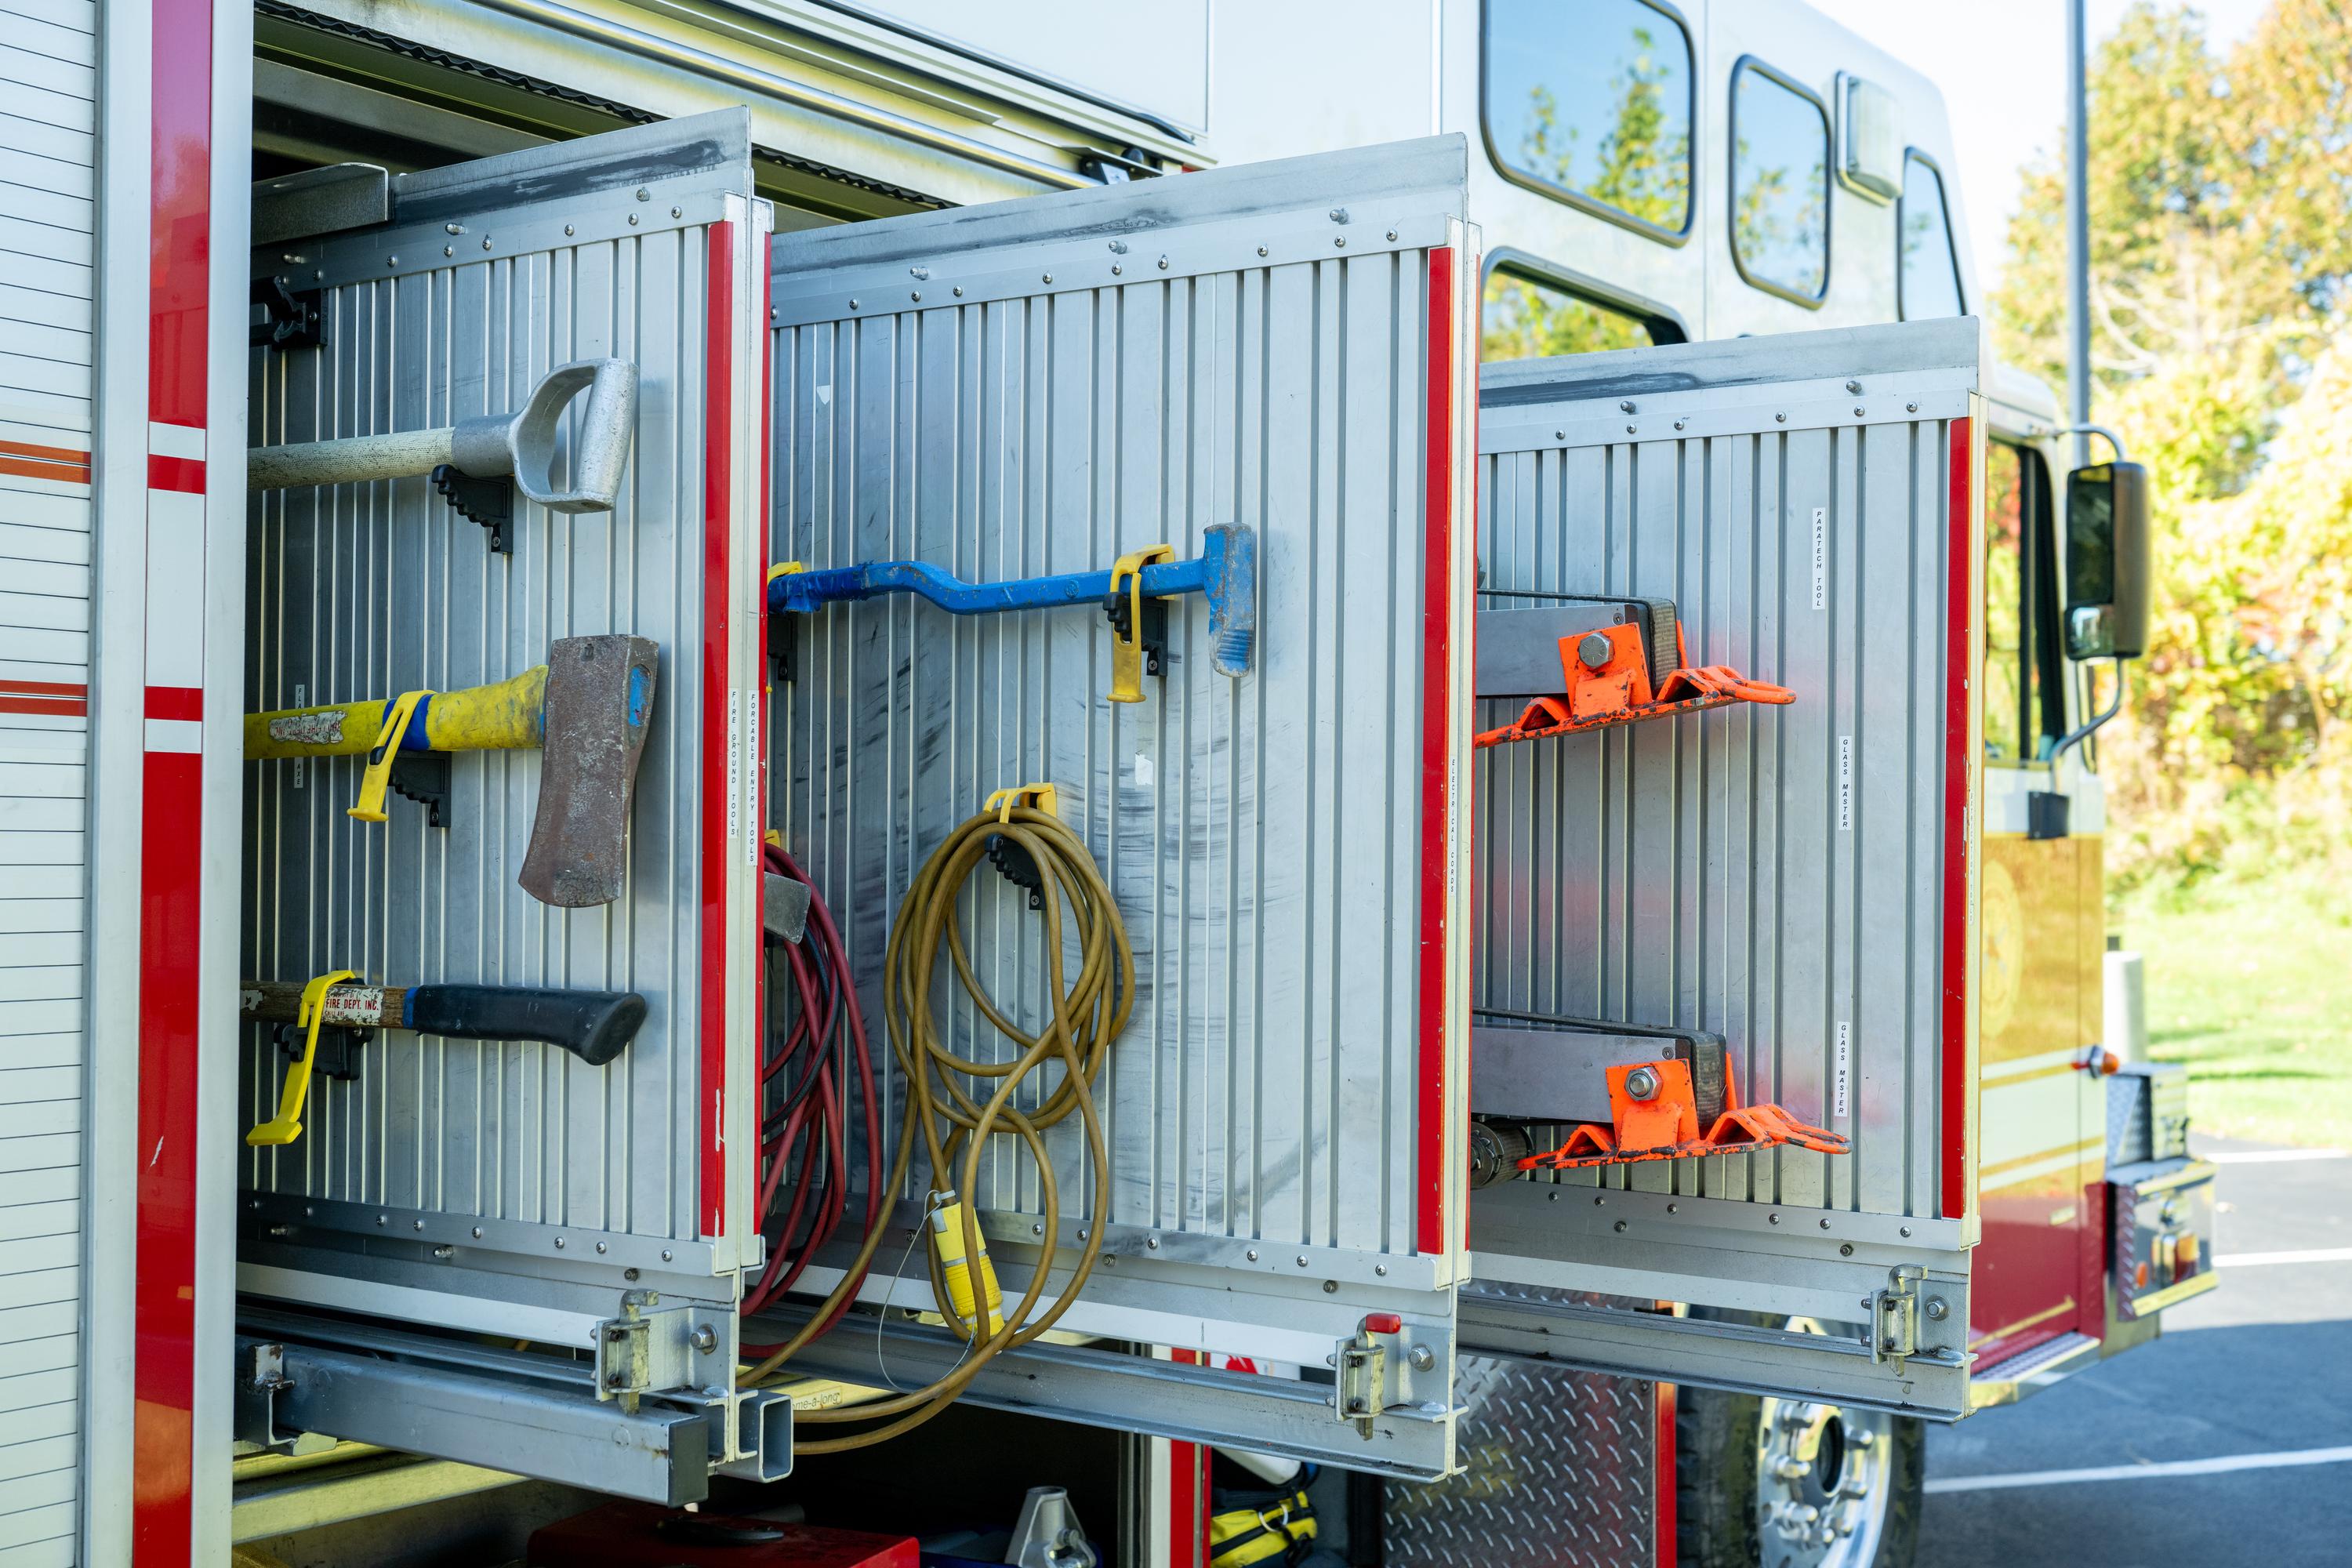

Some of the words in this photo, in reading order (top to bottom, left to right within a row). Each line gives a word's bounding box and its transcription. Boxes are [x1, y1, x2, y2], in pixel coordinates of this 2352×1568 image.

[325, 998, 340, 1009] FIRE
[343, 999, 361, 1010] DEPT.
[365, 1000, 379, 1011] INC.
